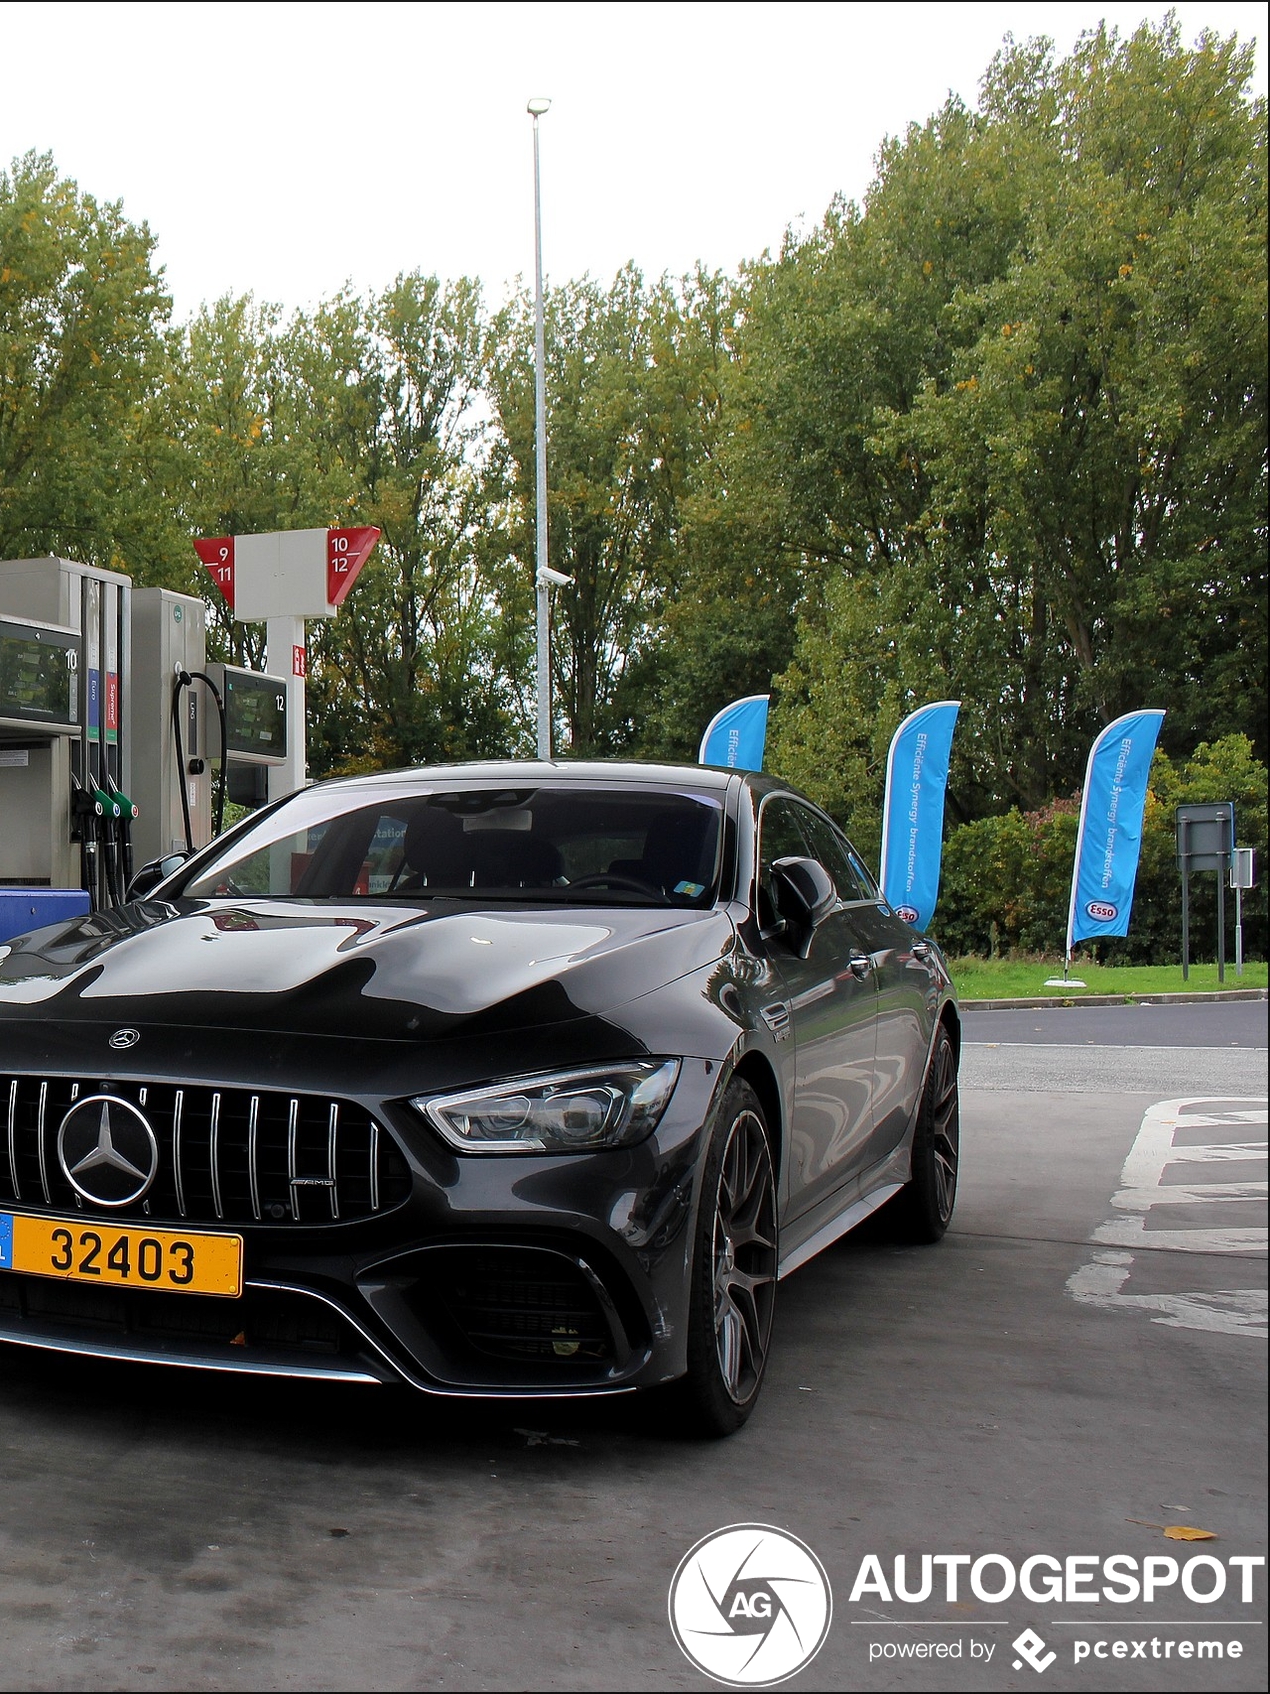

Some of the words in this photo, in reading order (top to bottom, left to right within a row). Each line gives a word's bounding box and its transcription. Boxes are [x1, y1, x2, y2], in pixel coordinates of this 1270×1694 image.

[220, 547, 228, 562] 9
[331, 537, 348, 552] 10
[218, 566, 231, 582] 11
[331, 558, 348, 573] 12
[66, 648, 78, 670] 10
[276, 694, 284, 712] 12
[727, 729, 739, 768] Efficiën
[912, 732, 927, 781] Efficiënte
[1113, 738, 1131, 783] Efficiënte
[908, 782, 921, 822] Synergy
[1106, 785, 1122, 822] Synergy
[906, 828, 918, 892] brandstoffen
[1101, 828, 1118, 888] brandstoffen
[1090, 905, 1114, 917] Esso
[51, 1228, 194, 1284] 32403
